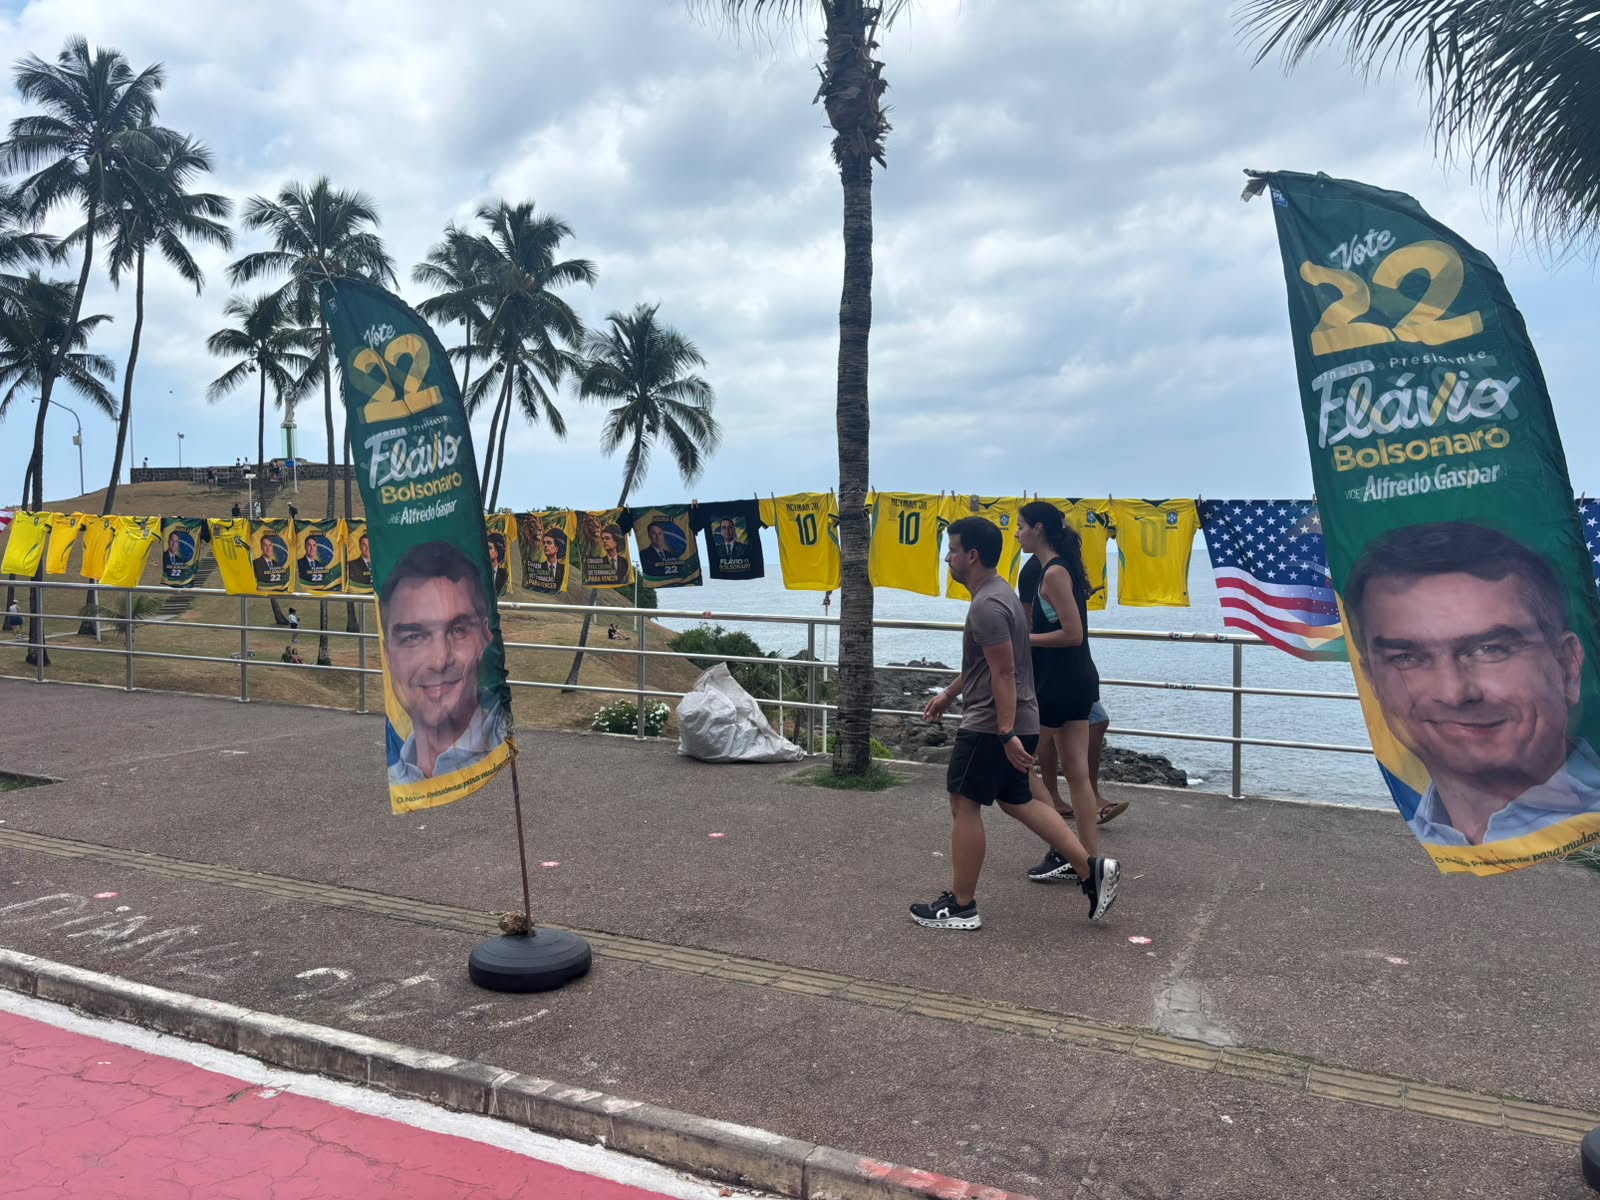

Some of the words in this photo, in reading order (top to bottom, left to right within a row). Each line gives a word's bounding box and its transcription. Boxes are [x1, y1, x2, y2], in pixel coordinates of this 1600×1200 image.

[1330, 229, 1397, 272] Vote
[1300, 240, 1484, 356] 22
[364, 323, 396, 349] Vote
[353, 333, 443, 424] 22
[1311, 360, 1520, 449] Flávio
[364, 427, 462, 489] Flávio
[1332, 426, 1511, 472] Bolsonaro
[380, 472, 463, 505] Bolsonaro
[1344, 487, 1361, 500] VICE
[1363, 472, 1431, 502] Alfredo
[1434, 462, 1501, 490] Gaspar
[400, 506, 435, 526] Alfredo
[795, 513, 818, 546] 10
[897, 510, 921, 546] 10
[171, 569, 182, 577] 22
[270, 574, 281, 582] 22
[311, 574, 323, 582] 22
[664, 565, 679, 574] 22
[396, 796, 404, 804] O
[426, 784, 462, 799] Presidente
[1435, 856, 1444, 864] O
[1533, 847, 1562, 863] para
